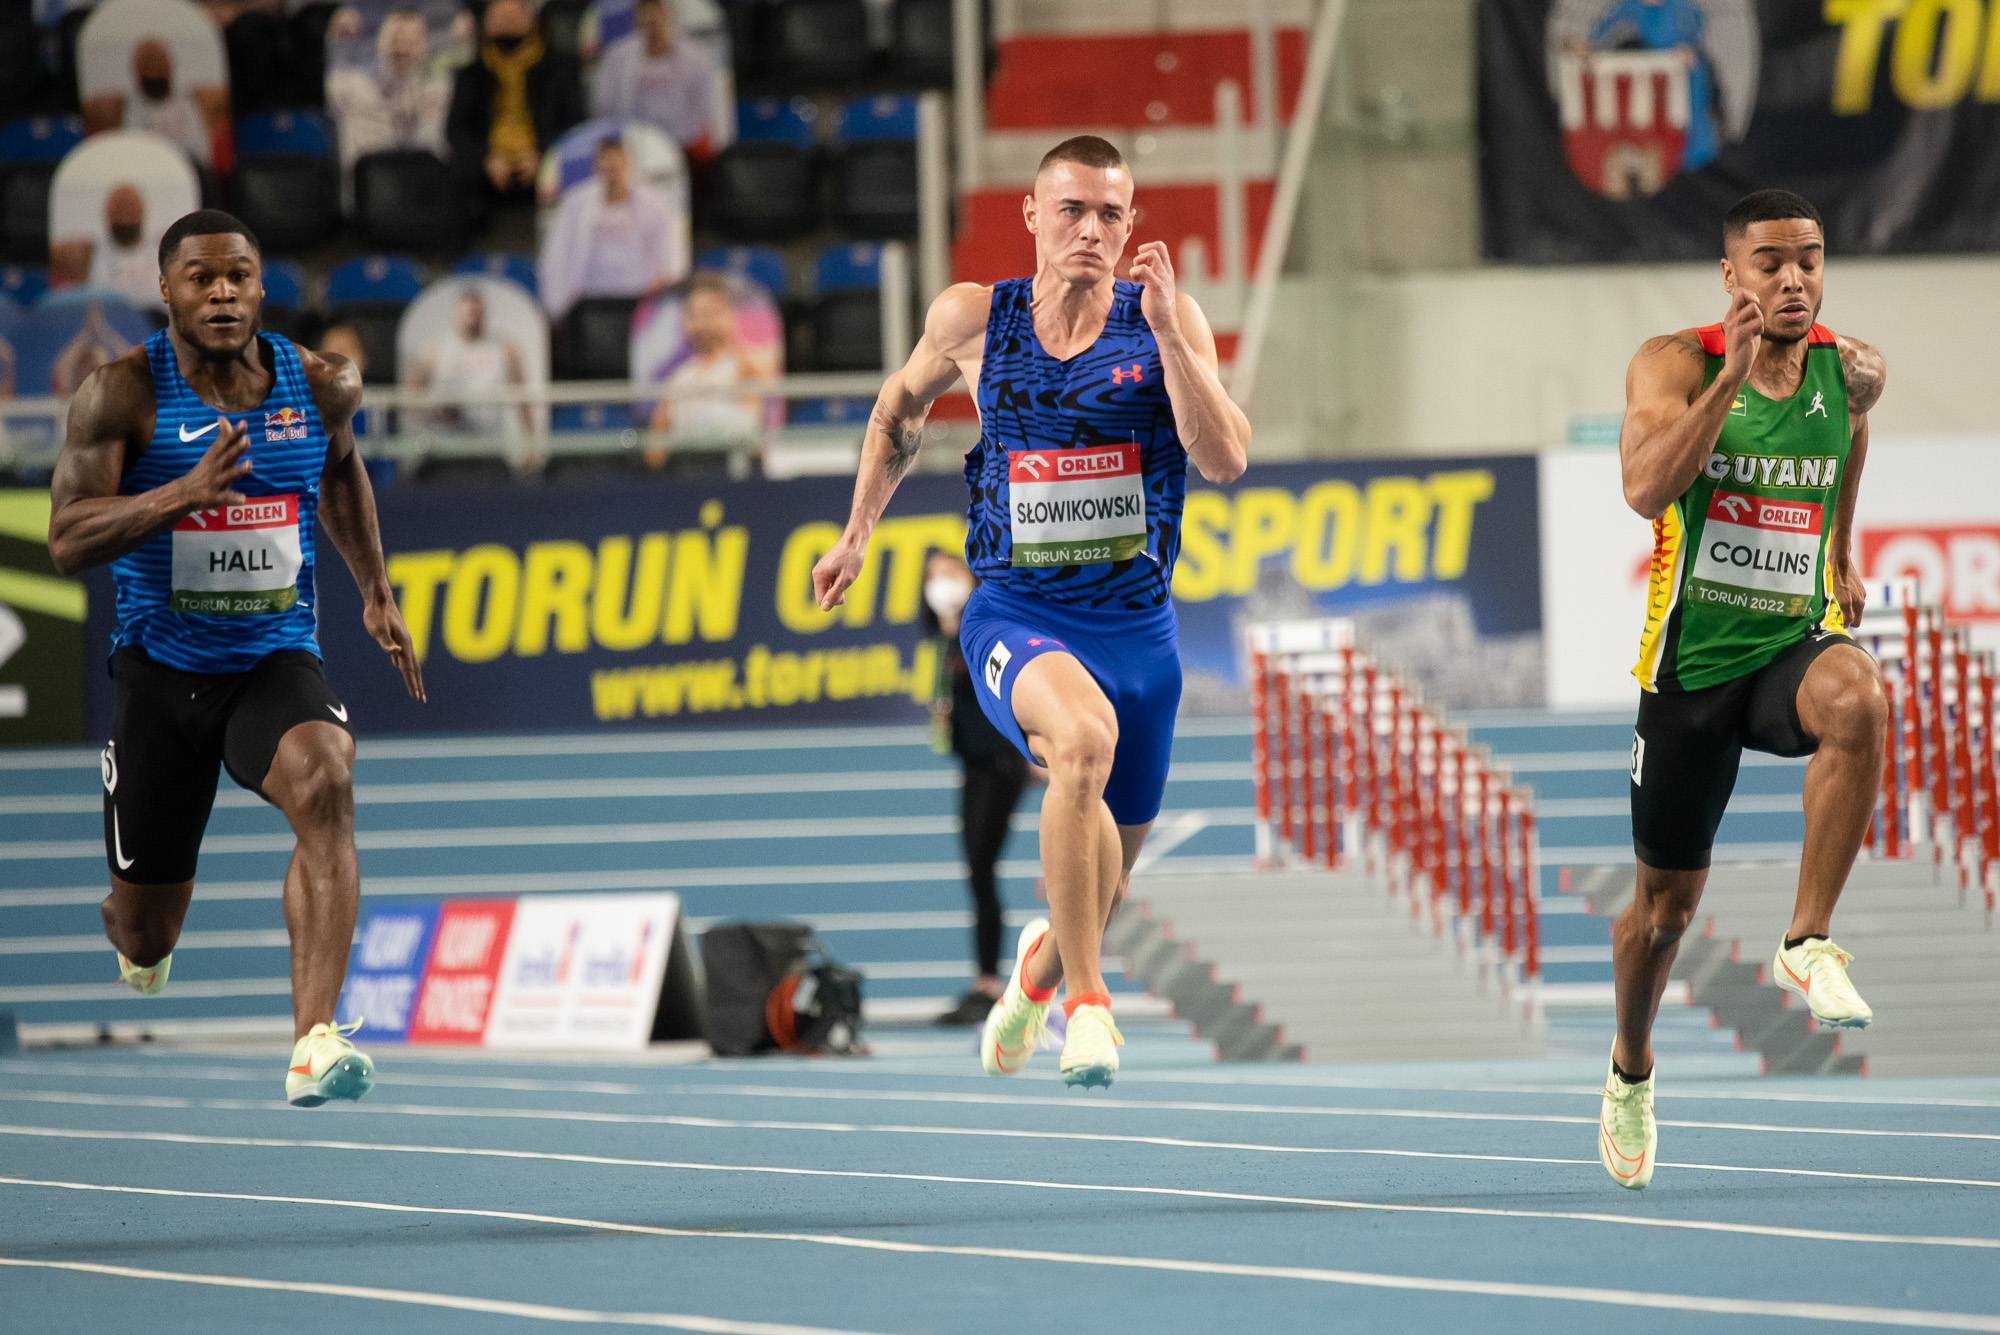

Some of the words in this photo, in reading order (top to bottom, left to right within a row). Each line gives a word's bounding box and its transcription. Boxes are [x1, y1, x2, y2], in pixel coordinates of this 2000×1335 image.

[265, 427, 288, 442] Red
[288, 425, 307, 440] Bull
[1061, 455, 1119, 472] ORLEN
[1703, 452, 1838, 488] GUYANA
[230, 504, 283, 522] ORLEN
[1017, 493, 1140, 524] SŁOWIKOWSKI
[1763, 508, 1808, 526] ORLEN
[1171, 468, 1496, 602] SPORT
[209, 548, 273, 573] HALL
[1023, 546, 1070, 563] TORUŃ
[1073, 546, 1111, 560] 2022
[1710, 541, 1810, 576] COLLINS
[179, 596, 231, 612] TORUŃ
[233, 598, 271, 612] 2022
[1699, 585, 1748, 608] TORUŃ
[1749, 596, 1786, 614] 2022
[990, 655, 1002, 686] 4
[1630, 734, 1639, 776] 3
